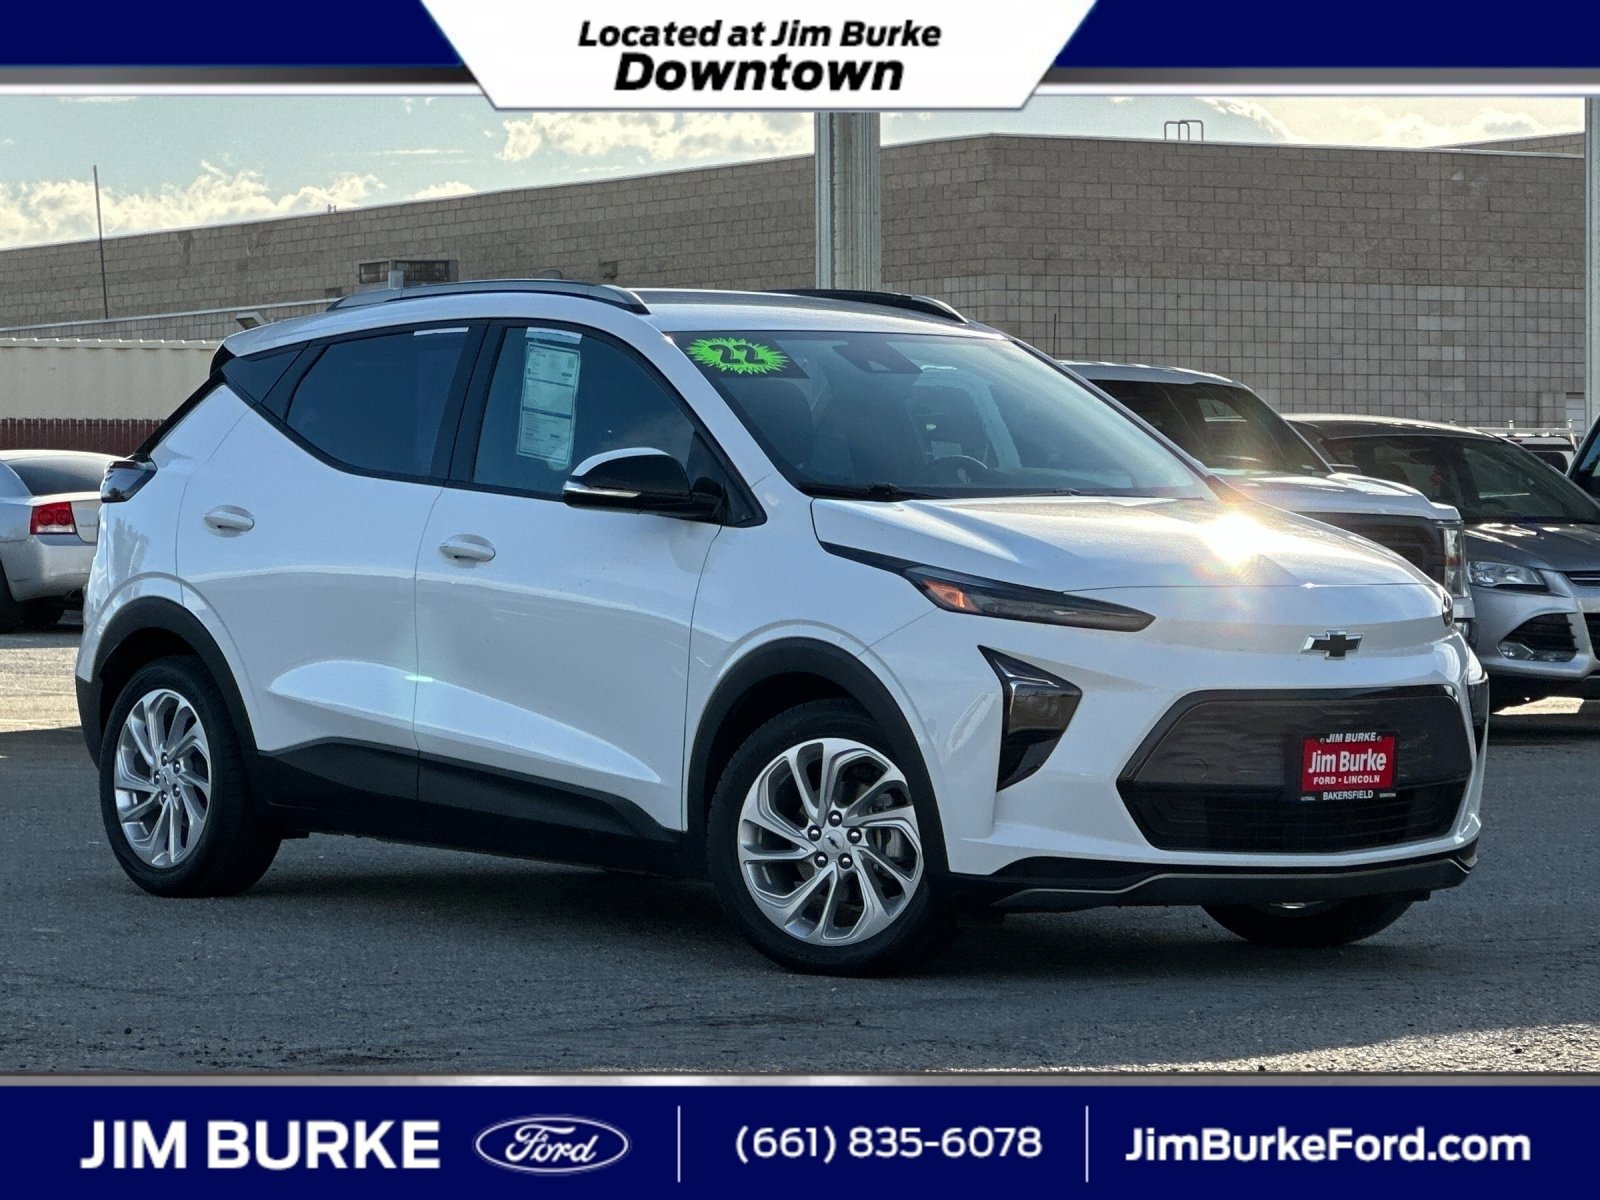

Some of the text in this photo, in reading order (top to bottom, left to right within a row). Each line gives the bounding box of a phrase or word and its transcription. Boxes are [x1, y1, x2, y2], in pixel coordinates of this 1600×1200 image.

[707, 344, 767, 365] 22
[1326, 732, 1377, 743] JIM BURKE
[1308, 748, 1387, 774] Jim Burke
[1313, 774, 1380, 785] FORD LINCOLN
[1322, 790, 1374, 801] BAKERSFIELD
